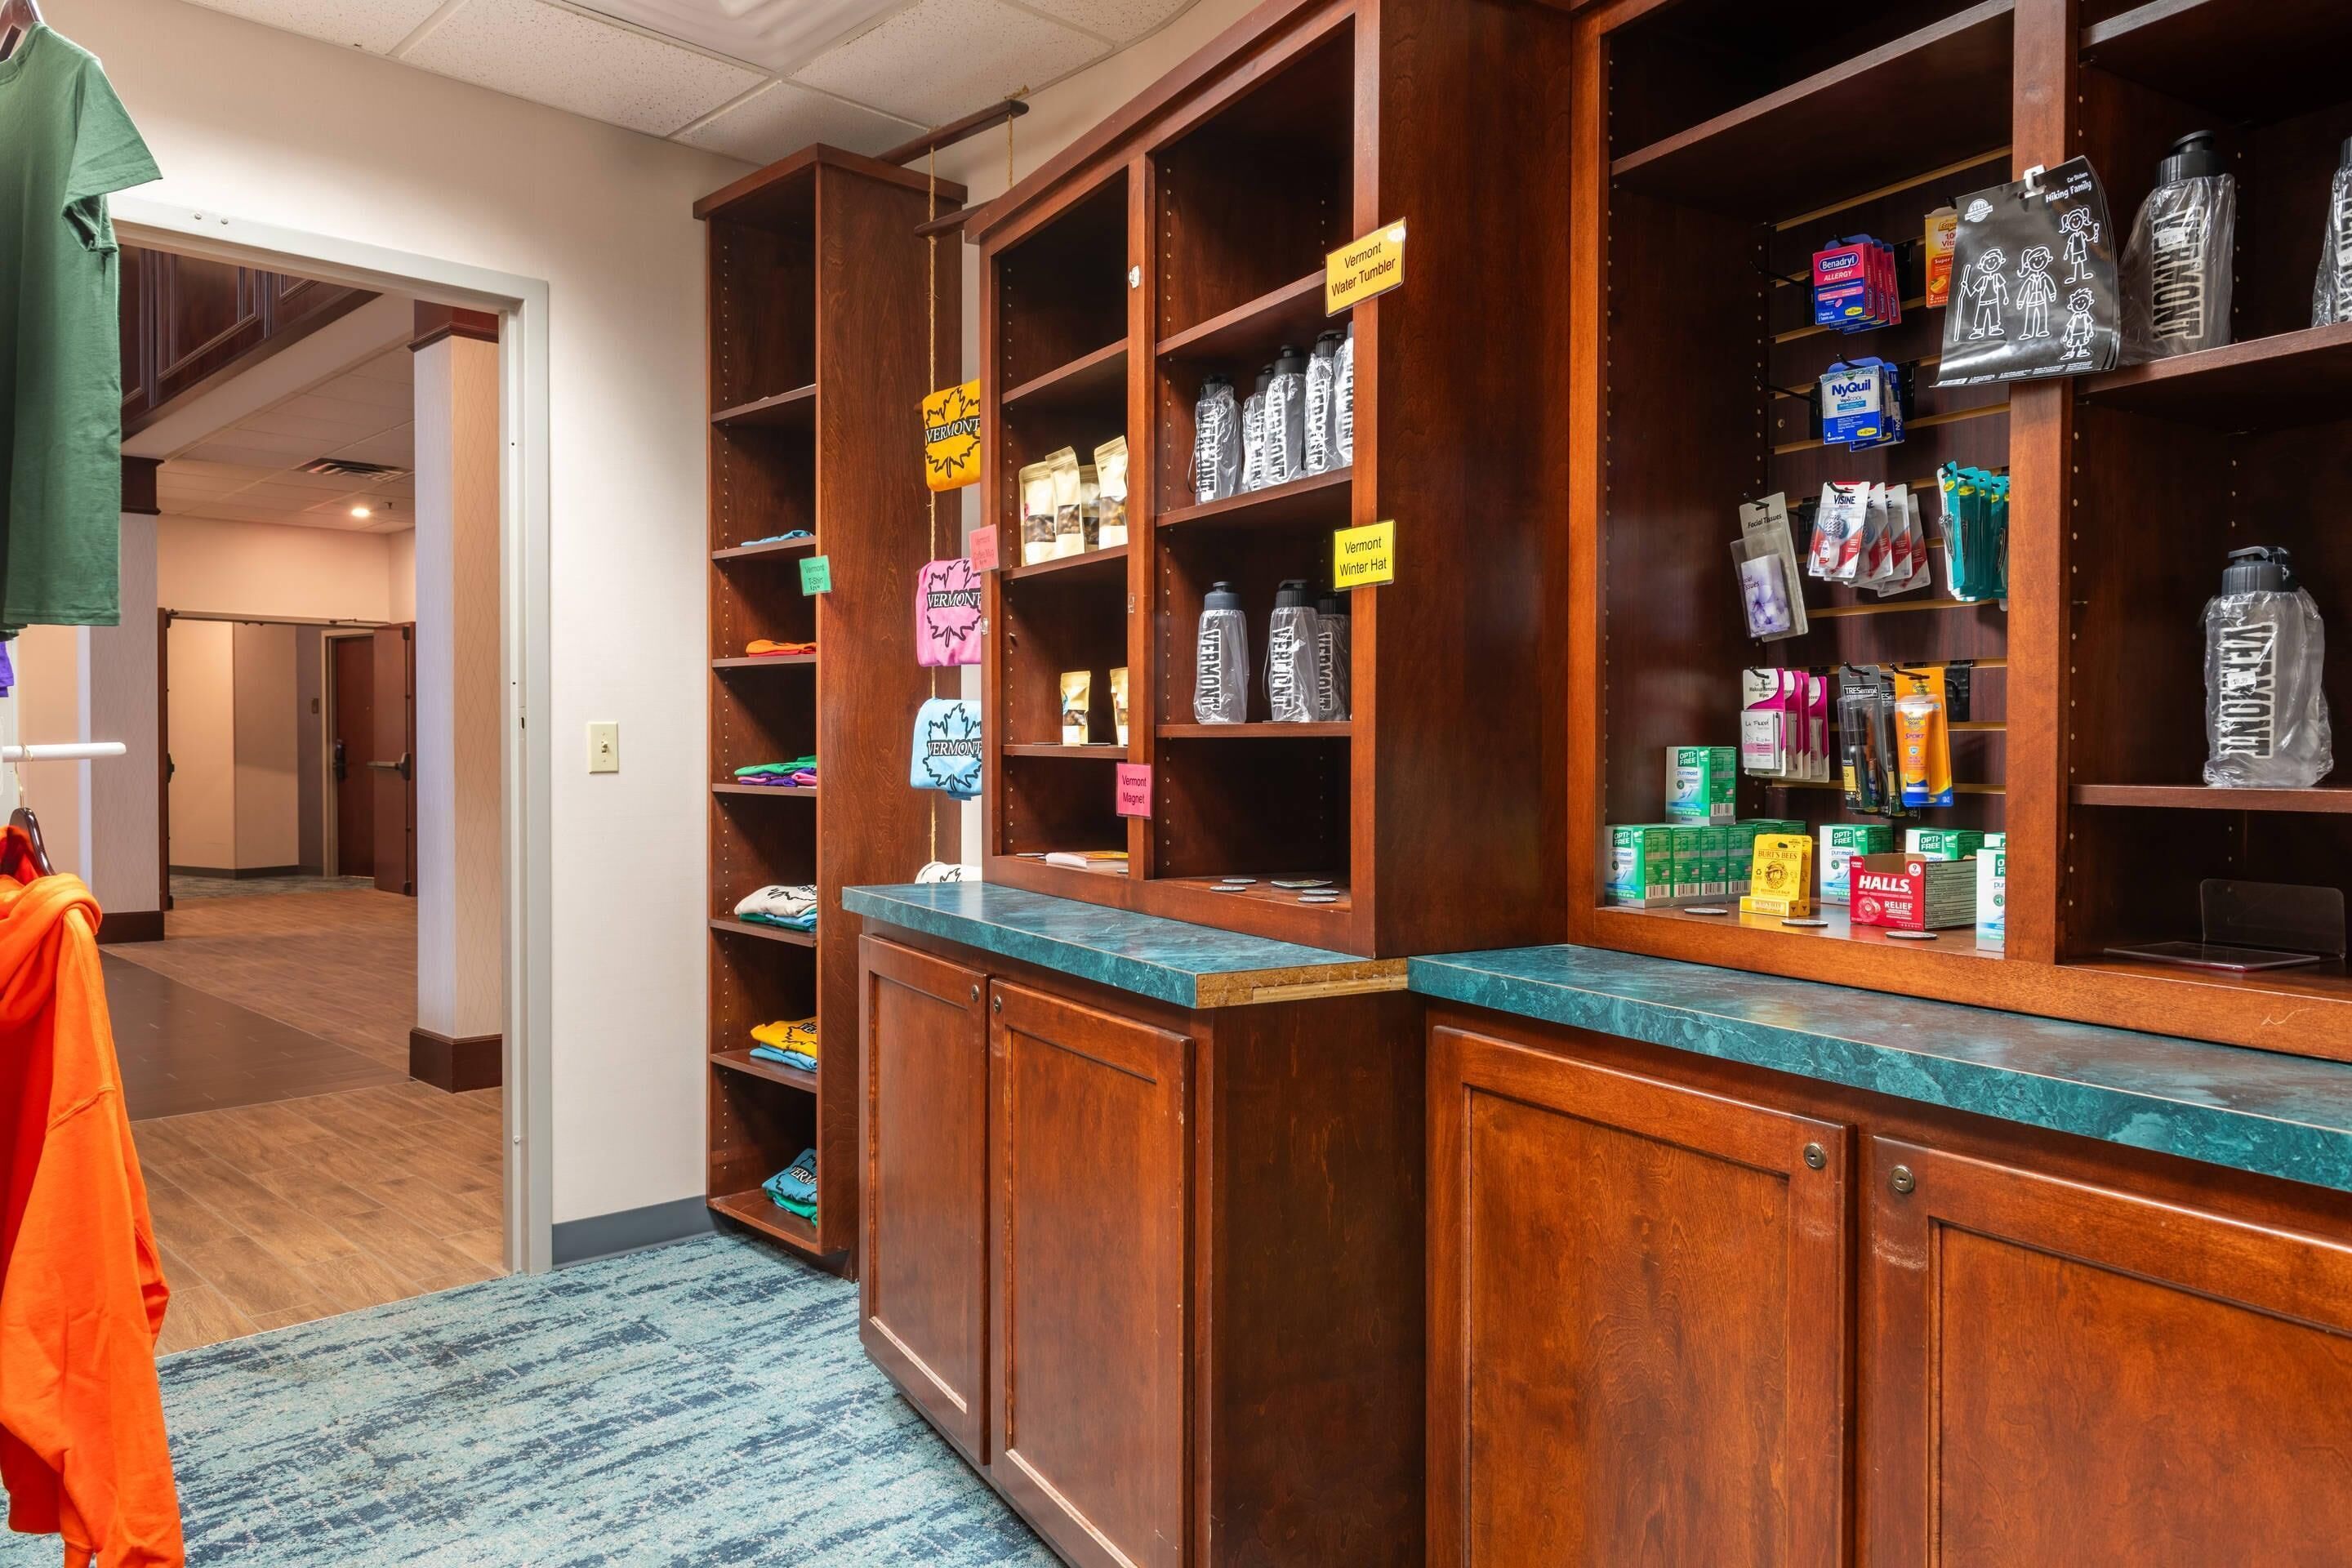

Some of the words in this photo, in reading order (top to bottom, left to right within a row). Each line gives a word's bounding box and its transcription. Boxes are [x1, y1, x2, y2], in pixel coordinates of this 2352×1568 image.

[2045, 188, 2069, 203] Hiking
[2070, 180, 2092, 195] Family
[1344, 241, 1382, 269] Vermont
[1822, 255, 1855, 270] Benadryl
[1331, 276, 1356, 296] Water
[1359, 258, 1396, 283] Tumbler
[1824, 270, 1853, 282] ALLERGY
[1832, 379, 1871, 398] NyQuil
[925, 417, 980, 443] VERMONT
[1833, 494, 1856, 505] VISINE
[1748, 518, 1763, 529] Facial
[1763, 514, 1782, 523] Tissues
[1344, 536, 1382, 555] Vermont
[1339, 561, 1368, 577] Winter
[1370, 557, 1388, 572] Hat
[927, 592, 981, 608] VERMONT
[1200, 628, 1222, 710] VERMONT
[1844, 687, 1878, 695] TRESemmé
[2218, 621, 2277, 760] VERMONT
[927, 740, 982, 756] VERMONT
[1679, 751, 1696, 760] OPTI-
[1680, 757, 1696, 765] FREE
[1121, 775, 1147, 786] Vermont
[1123, 792, 1145, 806] Magnet
[1614, 831, 1631, 840] OPTI-
[1833, 831, 1851, 839] OPTI-
[1833, 837, 1852, 845] FREE
[1921, 835, 1940, 844] OPTI-
[1614, 838, 1631, 846] FREE
[1921, 842, 1940, 851] FREE
[1757, 850, 1780, 858] BURT'S
[1781, 852, 1797, 860] BEES
[1884, 901, 1913, 911] RELIEF
